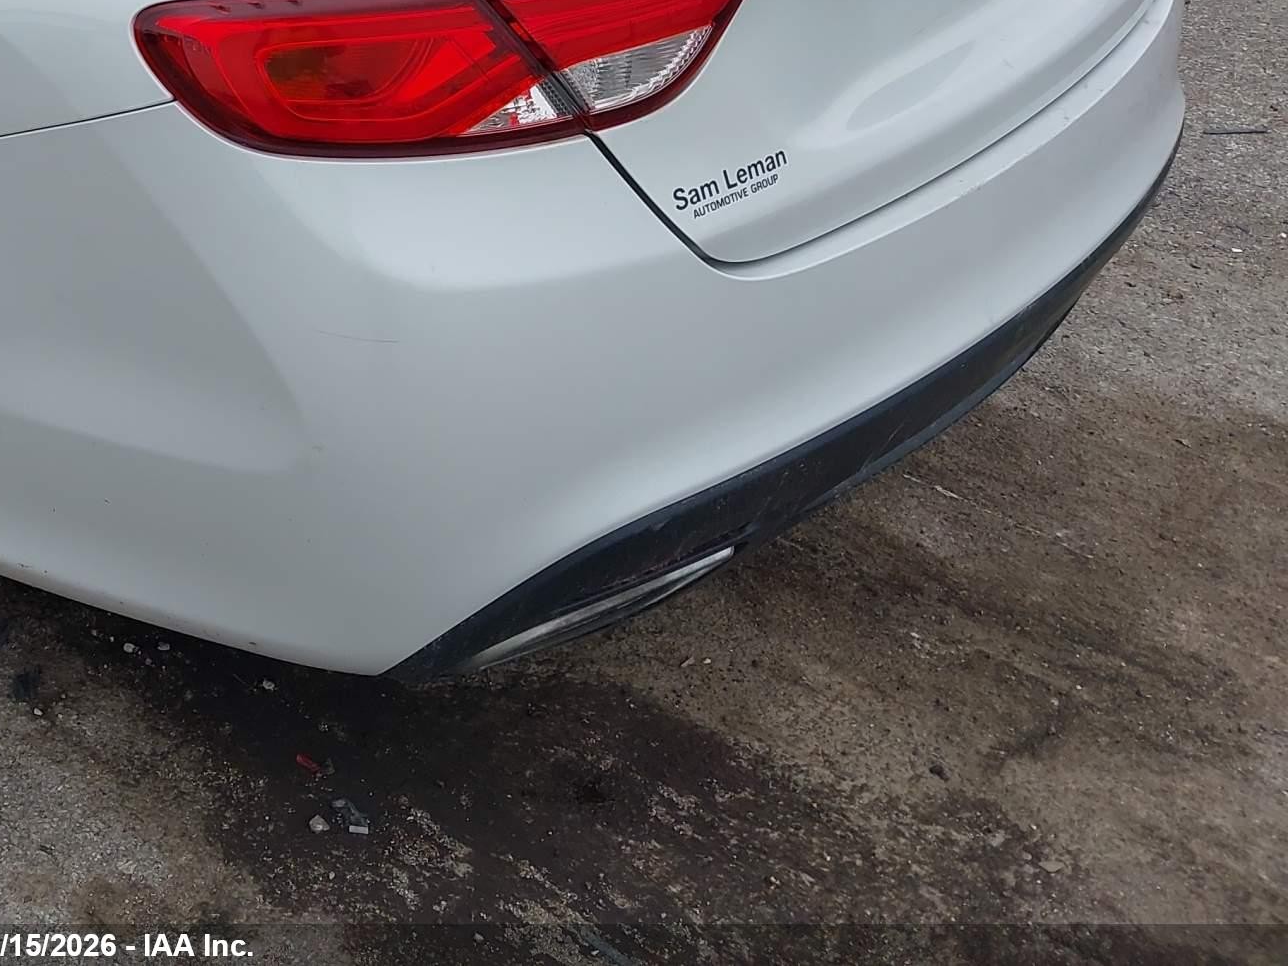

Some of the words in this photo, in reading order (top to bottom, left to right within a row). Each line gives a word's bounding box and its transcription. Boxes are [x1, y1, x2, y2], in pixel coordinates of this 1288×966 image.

[672, 179, 720, 211] Sam
[722, 149, 788, 190] Leman
[693, 187, 749, 220] AUTOMOTIVE
[750, 173, 779, 194] GROUP
